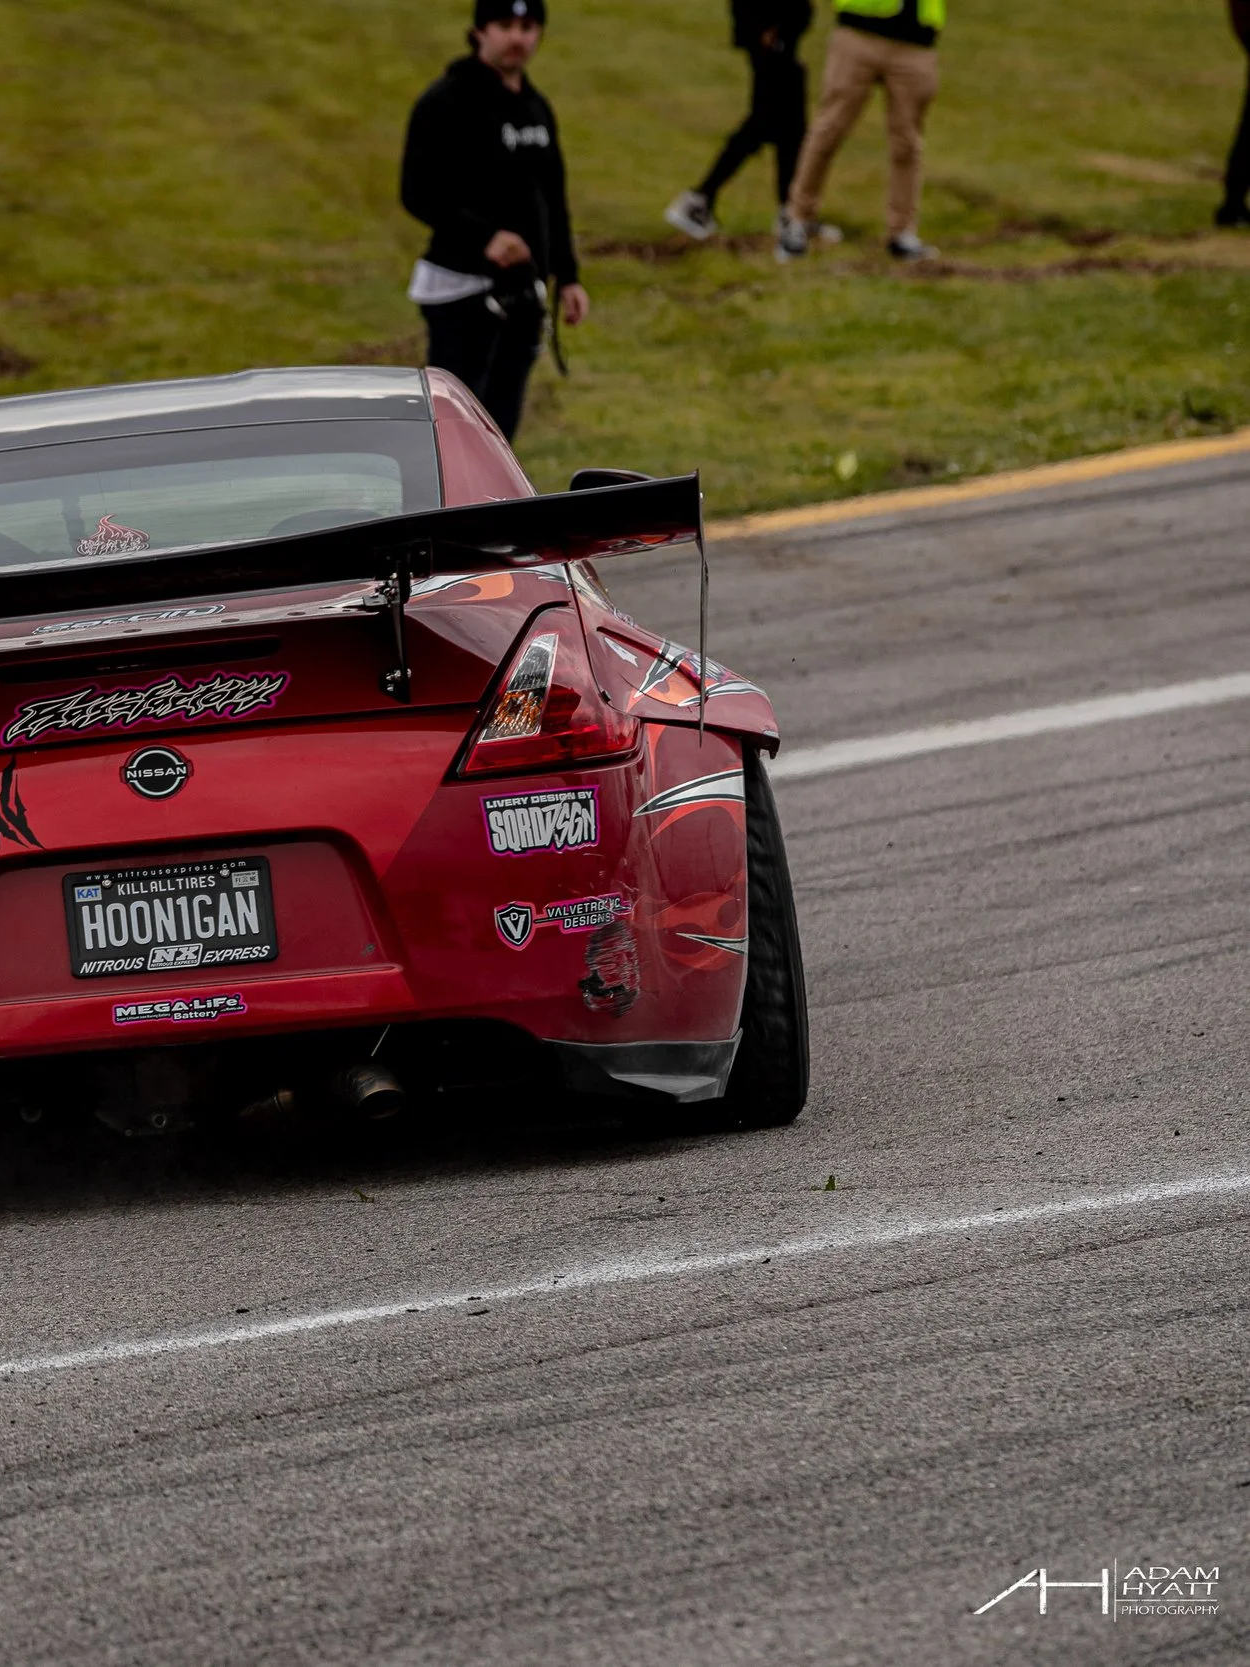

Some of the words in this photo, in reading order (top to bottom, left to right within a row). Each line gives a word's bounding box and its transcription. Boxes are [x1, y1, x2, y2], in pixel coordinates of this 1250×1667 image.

[126, 765, 187, 779] NISSAN
[486, 797, 529, 809] LIVERY
[530, 792, 575, 804] DESIGN
[577, 791, 592, 800] BY
[86, 860, 247, 881] www.nitrousexpress.com
[76, 887, 100, 899] KAT
[81, 890, 260, 950] HOON1GAN
[80, 957, 145, 974] NITROUS
[152, 946, 200, 963] NX
[202, 945, 271, 963] EXPRESS
[173, 1010, 218, 1020] Battery
